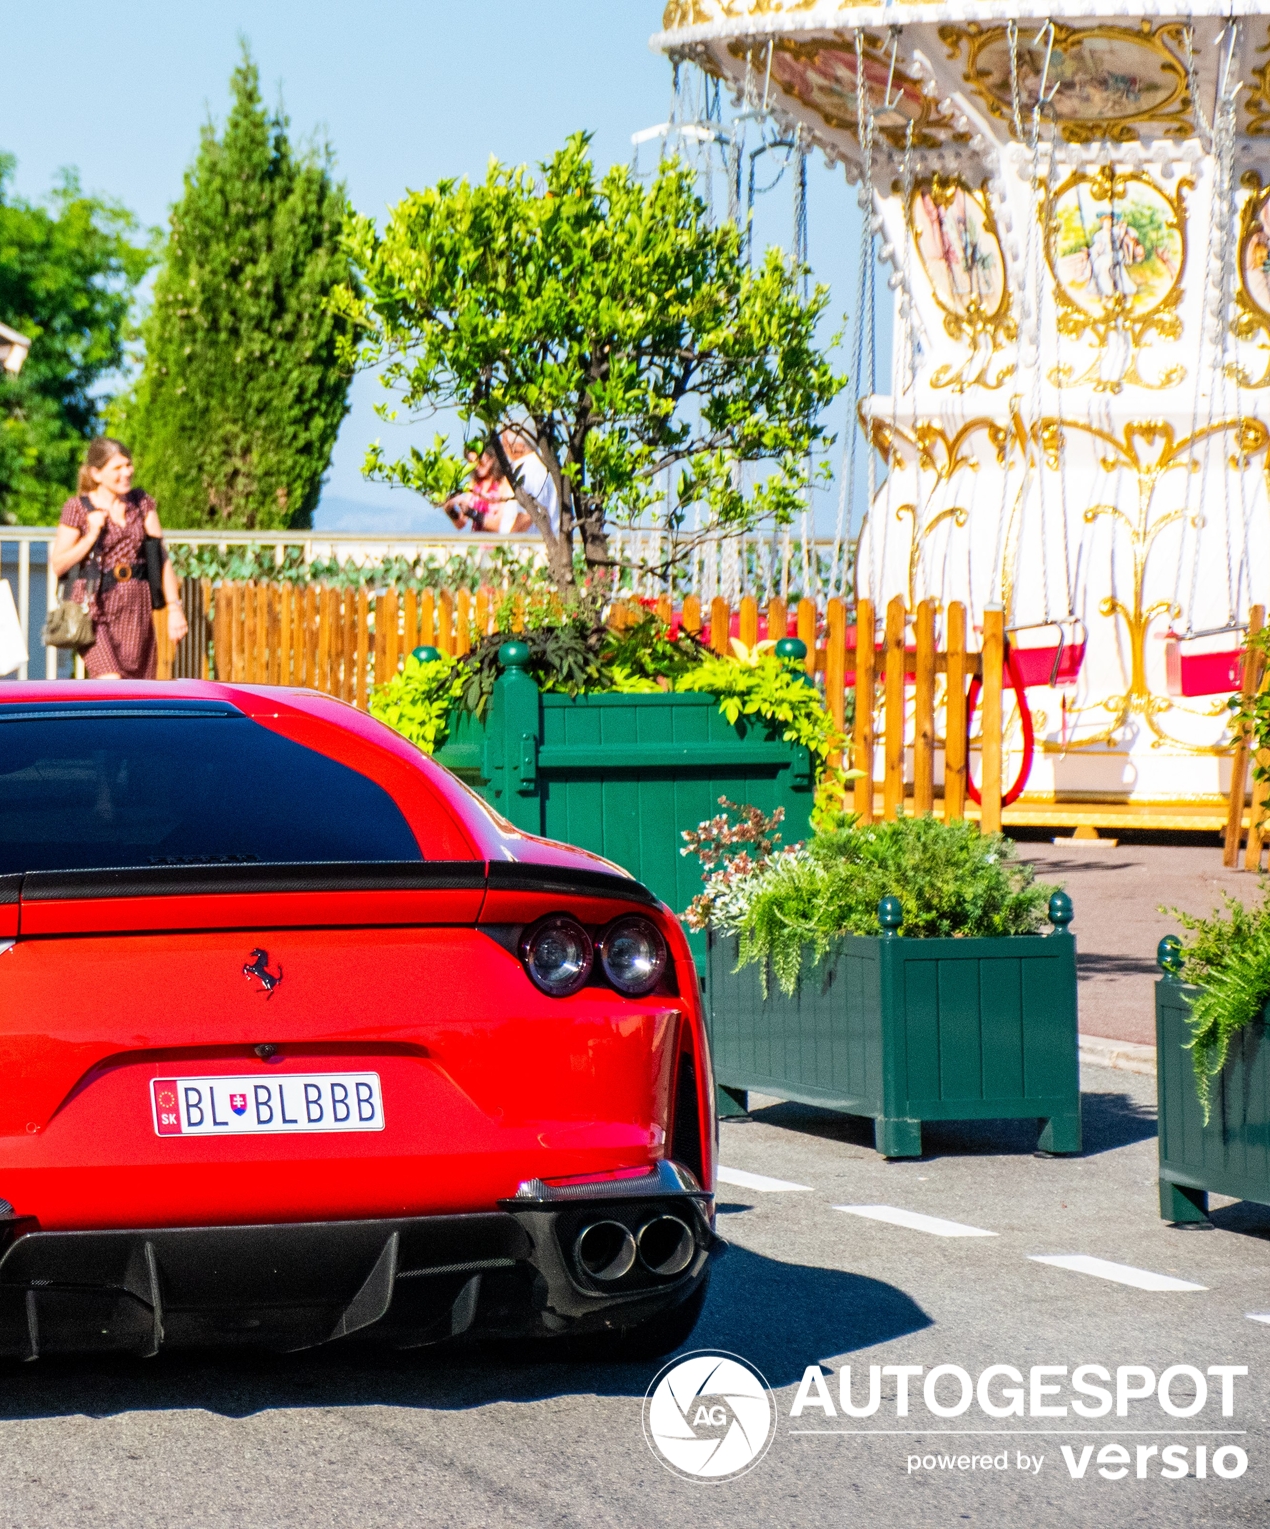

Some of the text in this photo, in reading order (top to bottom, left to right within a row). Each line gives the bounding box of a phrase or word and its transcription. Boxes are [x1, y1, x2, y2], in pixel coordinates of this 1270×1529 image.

[161, 1113, 178, 1125] SK
[183, 1082, 376, 1128] BL BLBBB
